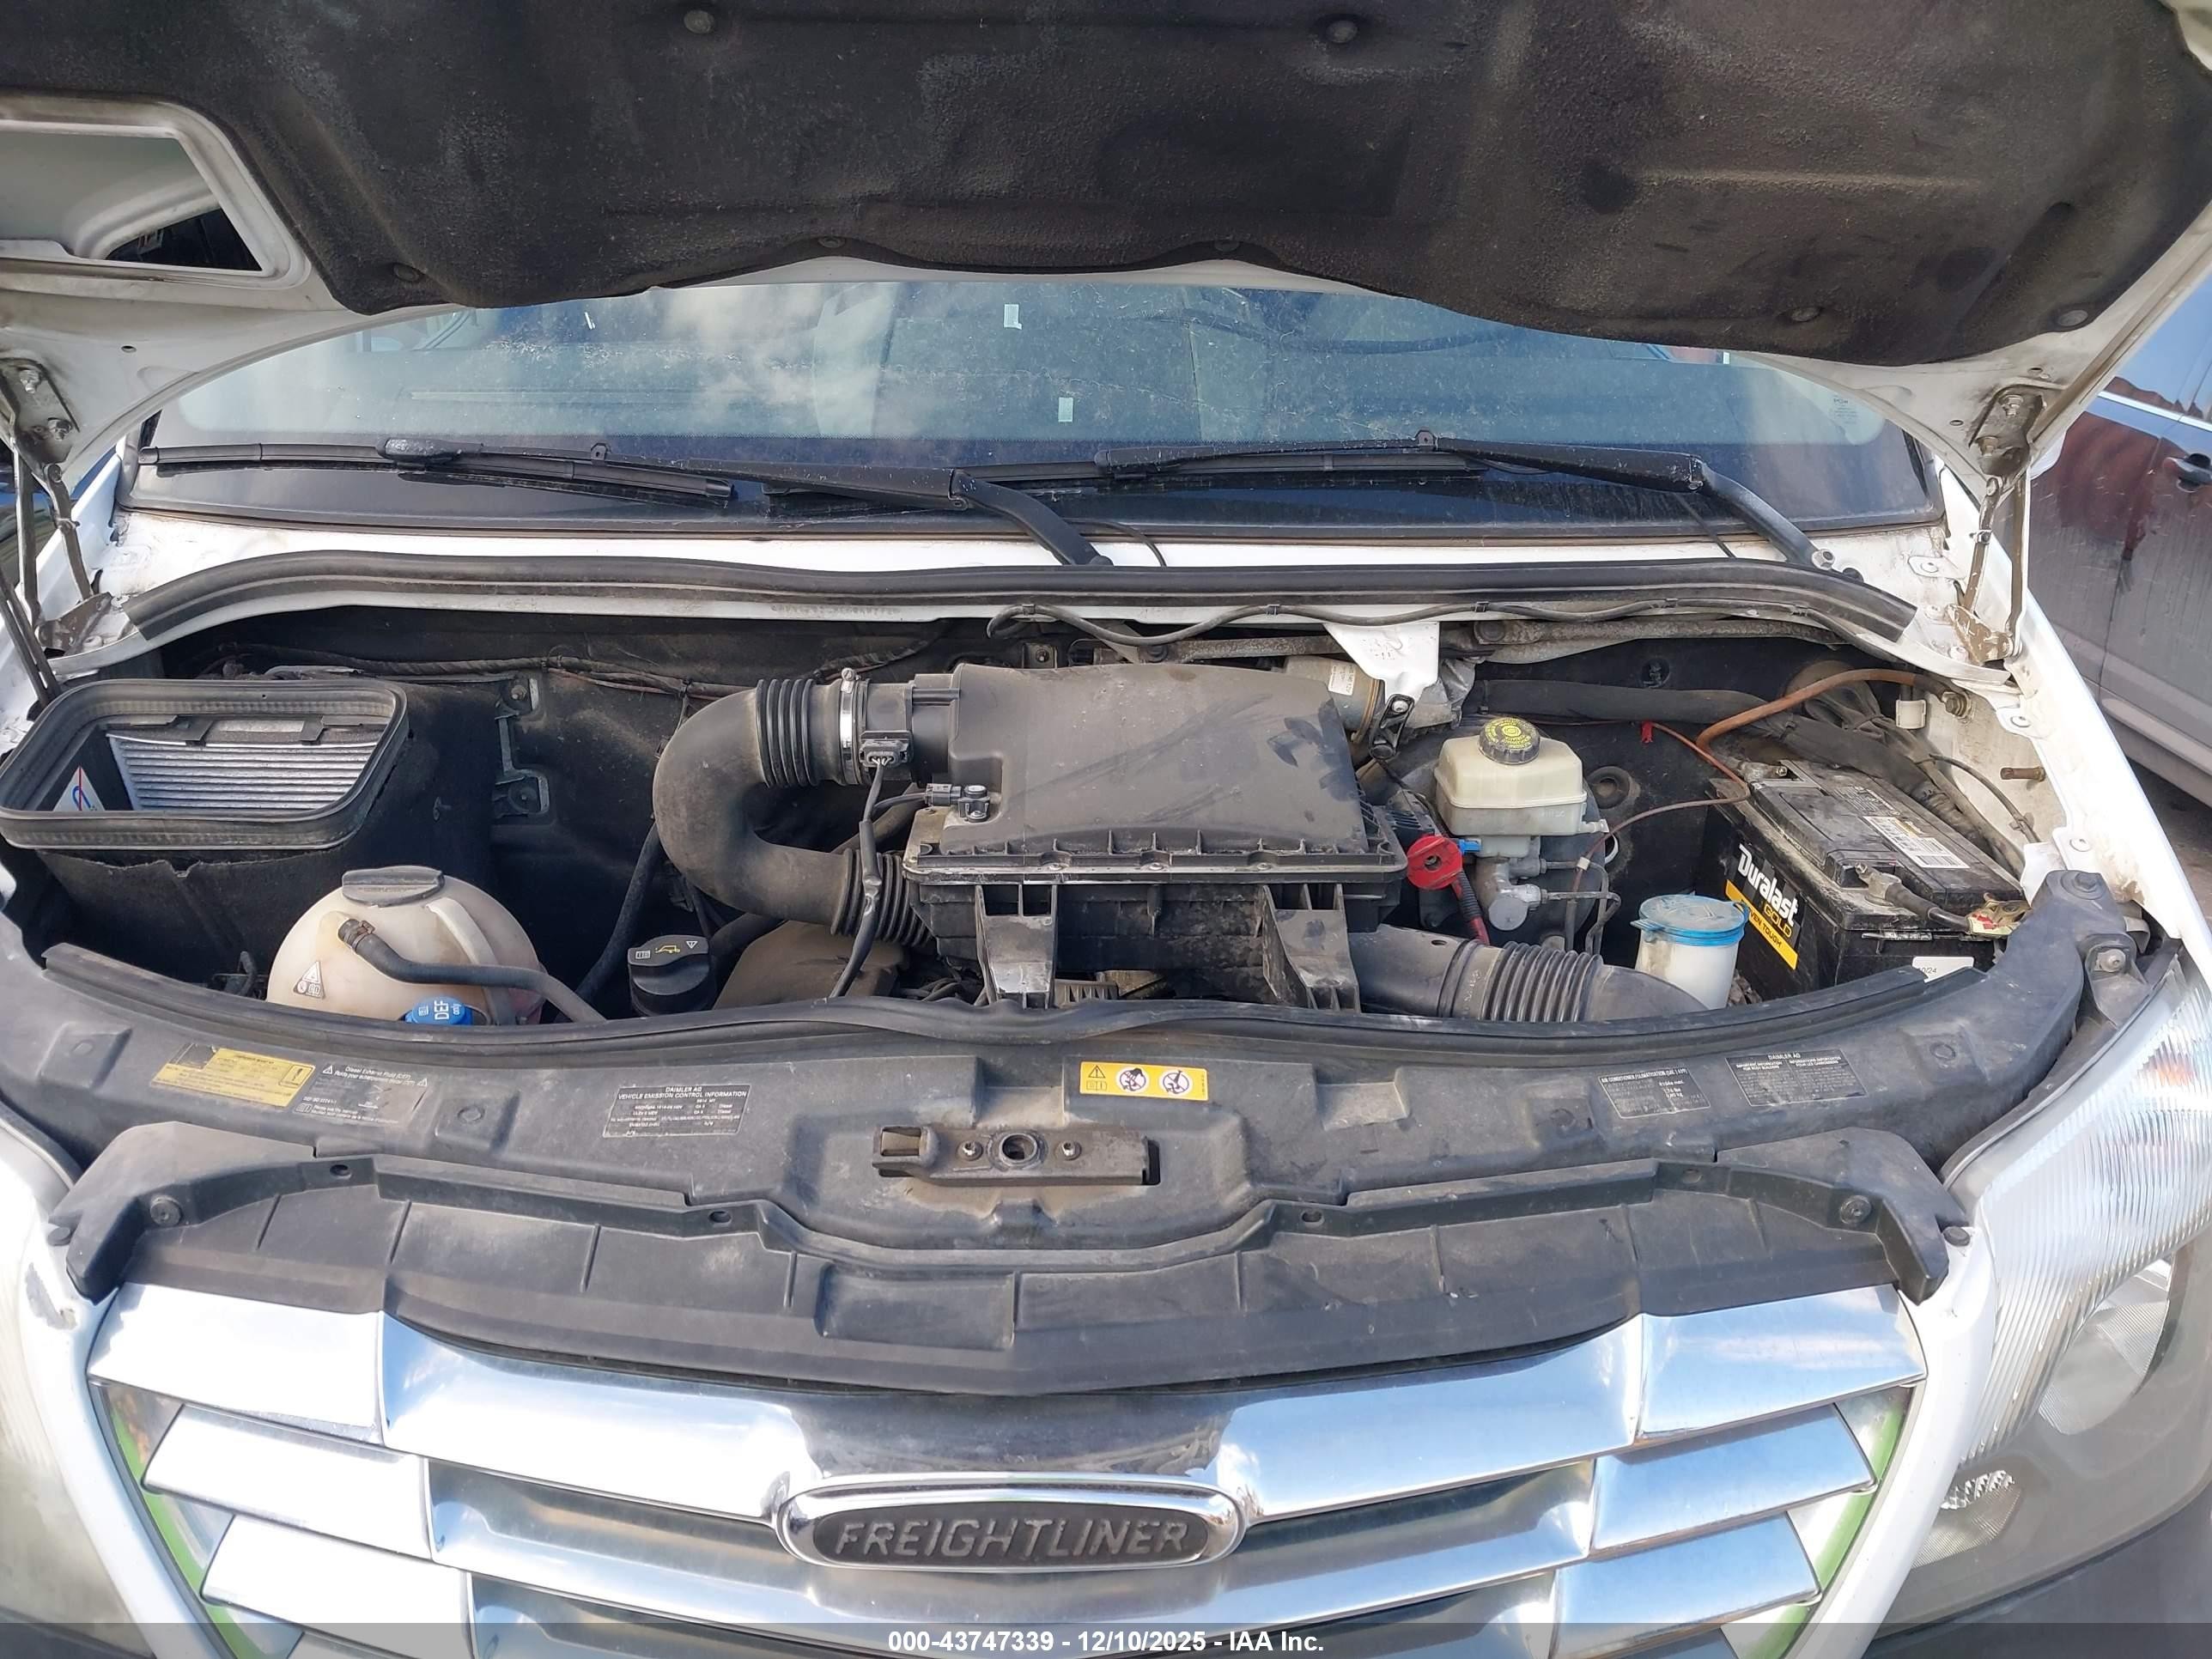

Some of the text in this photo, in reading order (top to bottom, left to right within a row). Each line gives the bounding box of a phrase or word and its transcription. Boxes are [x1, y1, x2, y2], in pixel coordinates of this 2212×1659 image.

[1738, 842, 1799, 927] Duralast
[1762, 923, 1783, 948] TOUGH
[1764, 903, 1792, 938] GOLD
[434, 1000, 449, 1020] DEF
[450, 1003, 462, 1016] only
[835, 1517, 1188, 1557] FREIGHTLINER
